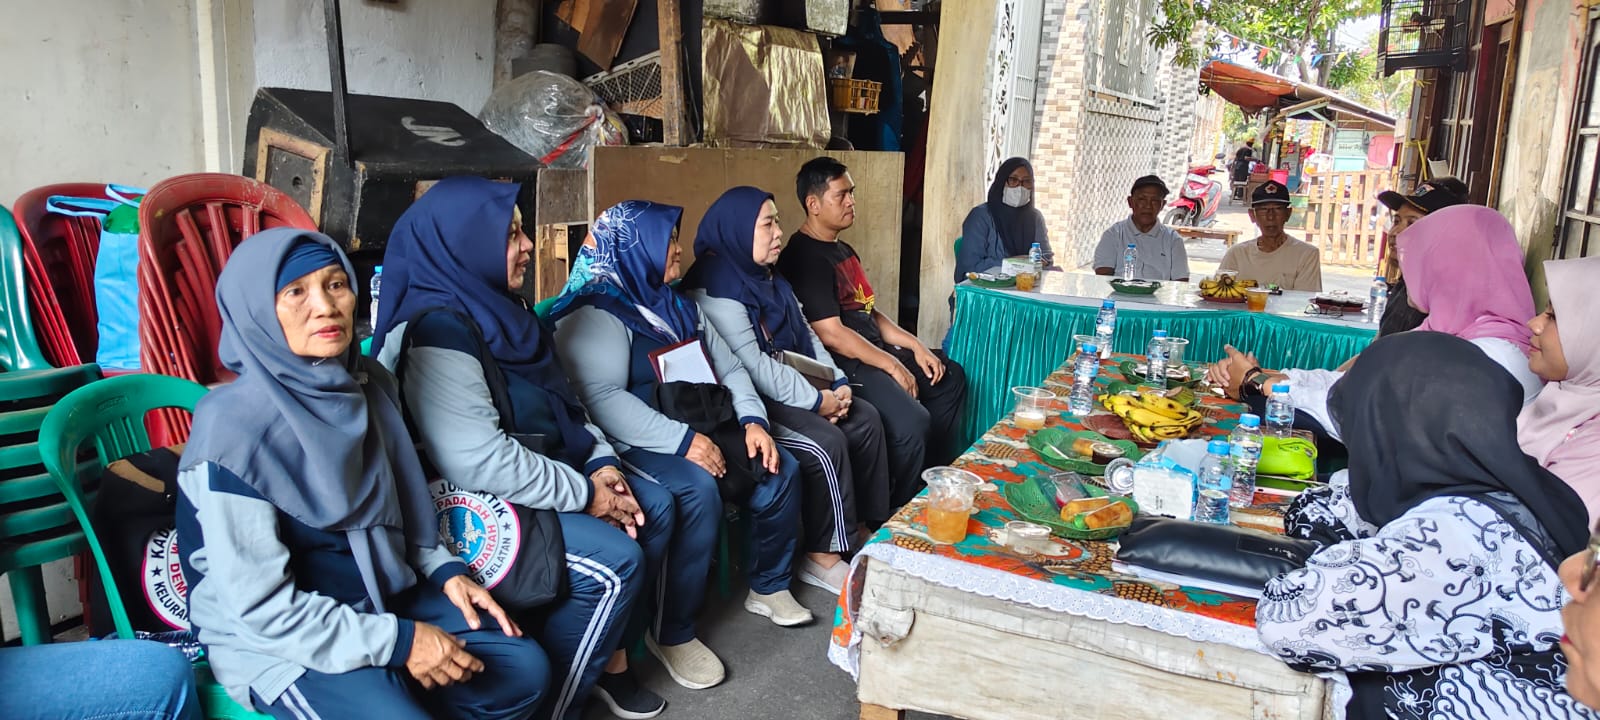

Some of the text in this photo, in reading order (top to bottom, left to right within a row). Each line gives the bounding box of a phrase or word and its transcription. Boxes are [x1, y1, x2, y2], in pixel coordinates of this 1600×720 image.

[436, 496, 491, 520] PADALAH
[439, 482, 508, 518] JUNTIK
[469, 524, 496, 572] RDARAH
[485, 537, 511, 578] SELATAN
[170, 563, 188, 598] DEM
[154, 581, 190, 621] KELURA
